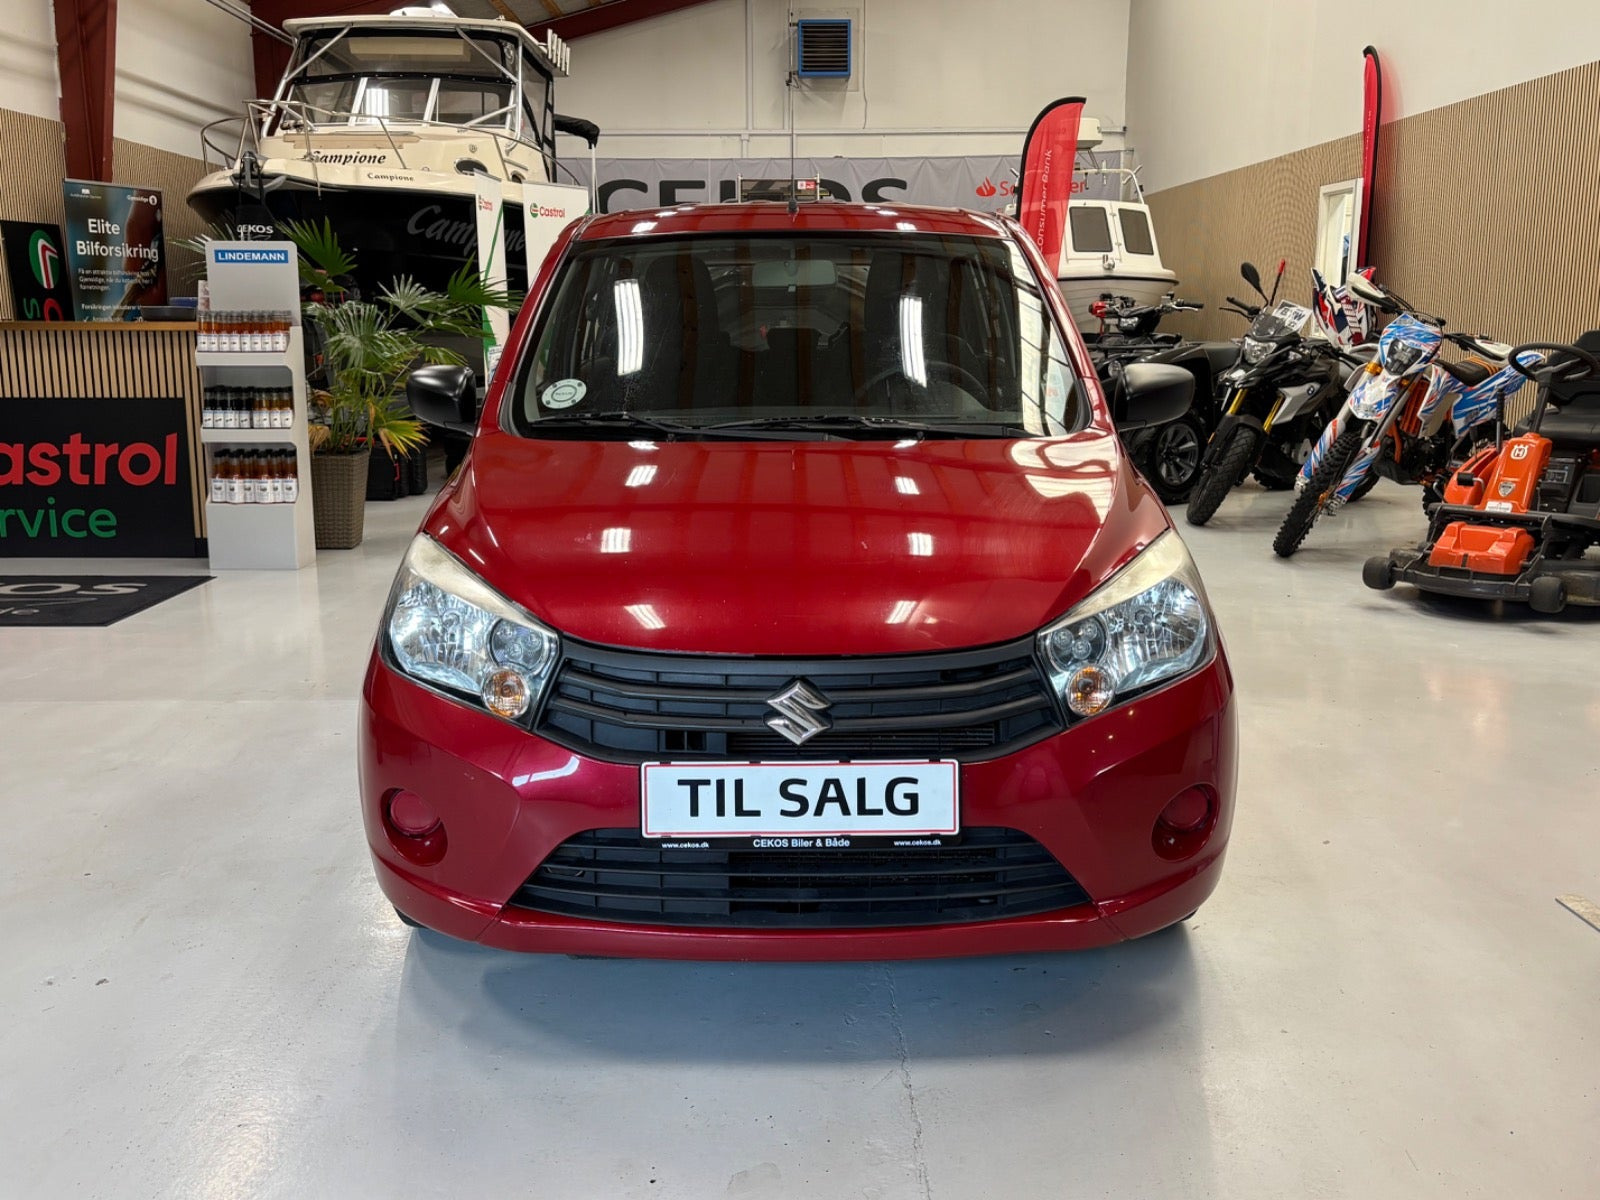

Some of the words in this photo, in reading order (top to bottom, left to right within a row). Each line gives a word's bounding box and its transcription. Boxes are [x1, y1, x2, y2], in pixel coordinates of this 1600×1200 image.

[1041, 149, 1053, 183] Bank
[367, 172, 415, 182] Campione
[539, 205, 566, 218] Castrol
[87, 217, 121, 235] Elite
[76, 240, 159, 263] Bilforsikring
[217, 252, 285, 261] LINDEMANN
[677, 778, 761, 818] TIL
[779, 776, 920, 818] SALG
[661, 841, 710, 849] www.cekos.dk
[752, 838, 789, 848] CEKOS
[791, 838, 813, 848] Biler
[815, 838, 823, 848] &
[825, 837, 850, 847] Både
[893, 839, 941, 847] www.cekos.dk
